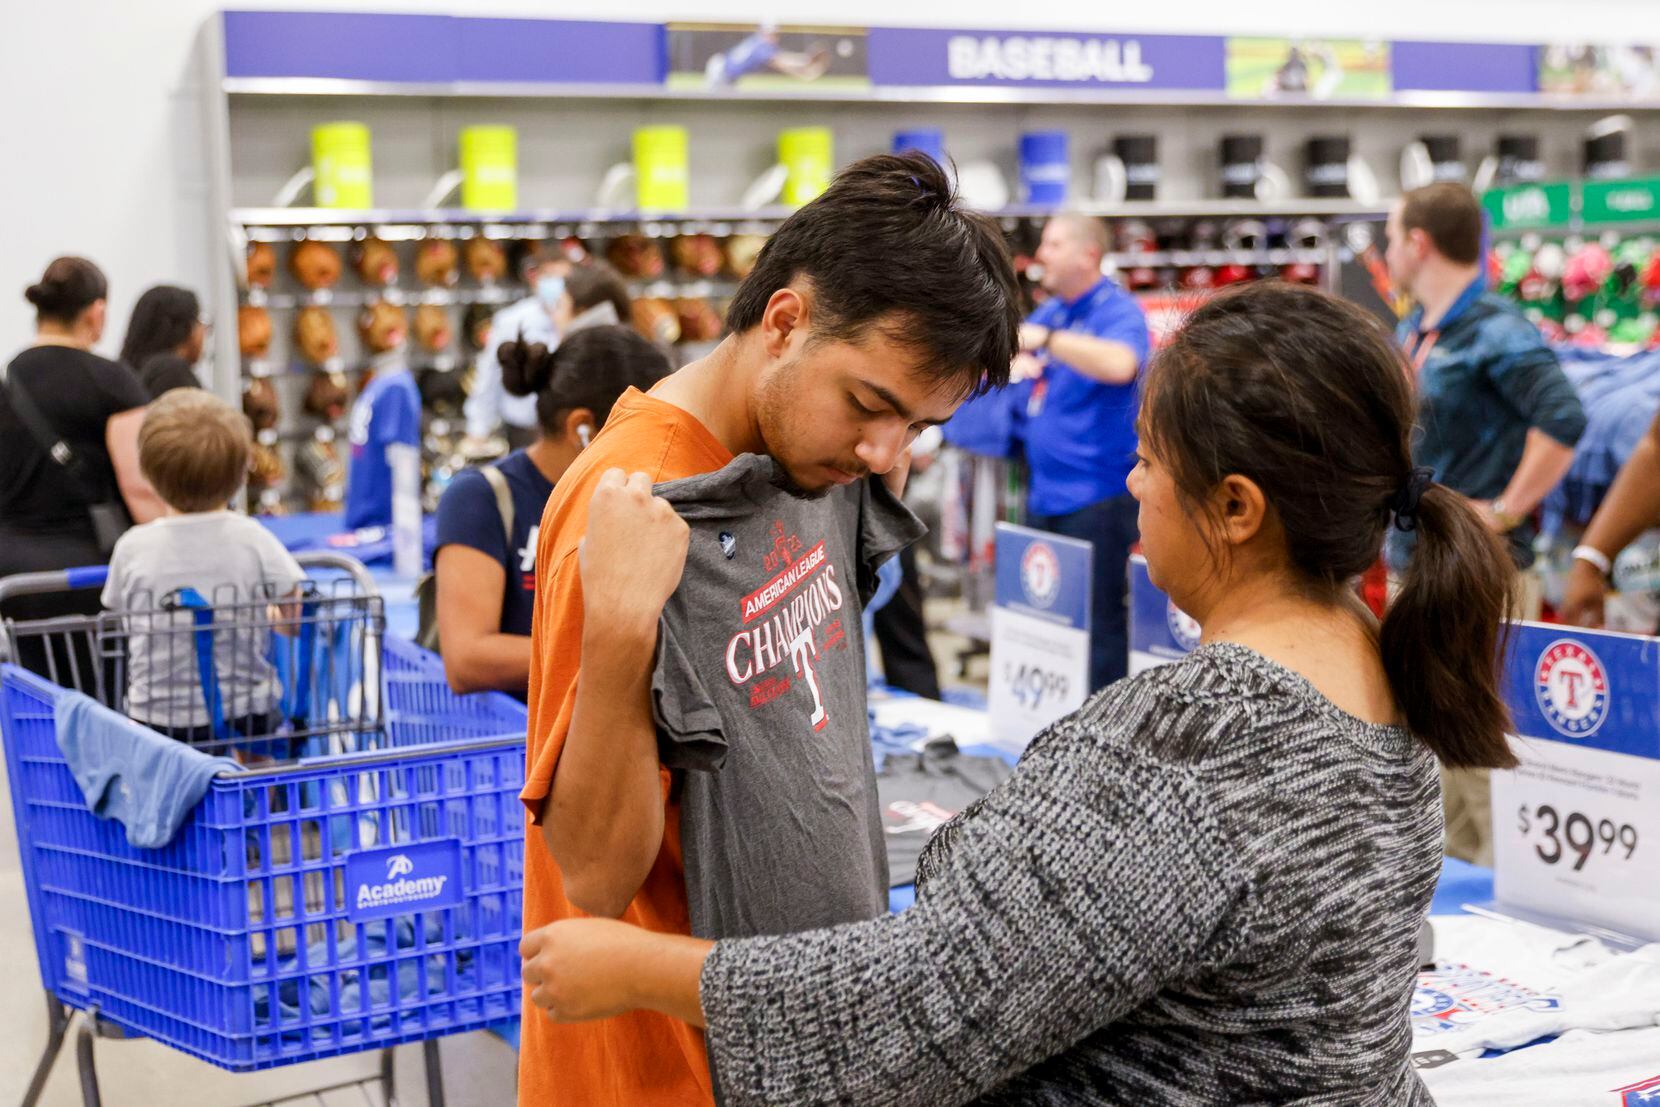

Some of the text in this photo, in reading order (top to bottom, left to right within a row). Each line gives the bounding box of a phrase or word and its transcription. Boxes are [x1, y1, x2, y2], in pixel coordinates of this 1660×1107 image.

[948, 35, 1153, 82] BASEBALL
[745, 545, 825, 618] AMERICAN LEAGUE
[726, 564, 843, 685] CHAMPIONS
[788, 626, 830, 734] T
[357, 875, 448, 904] Academy
